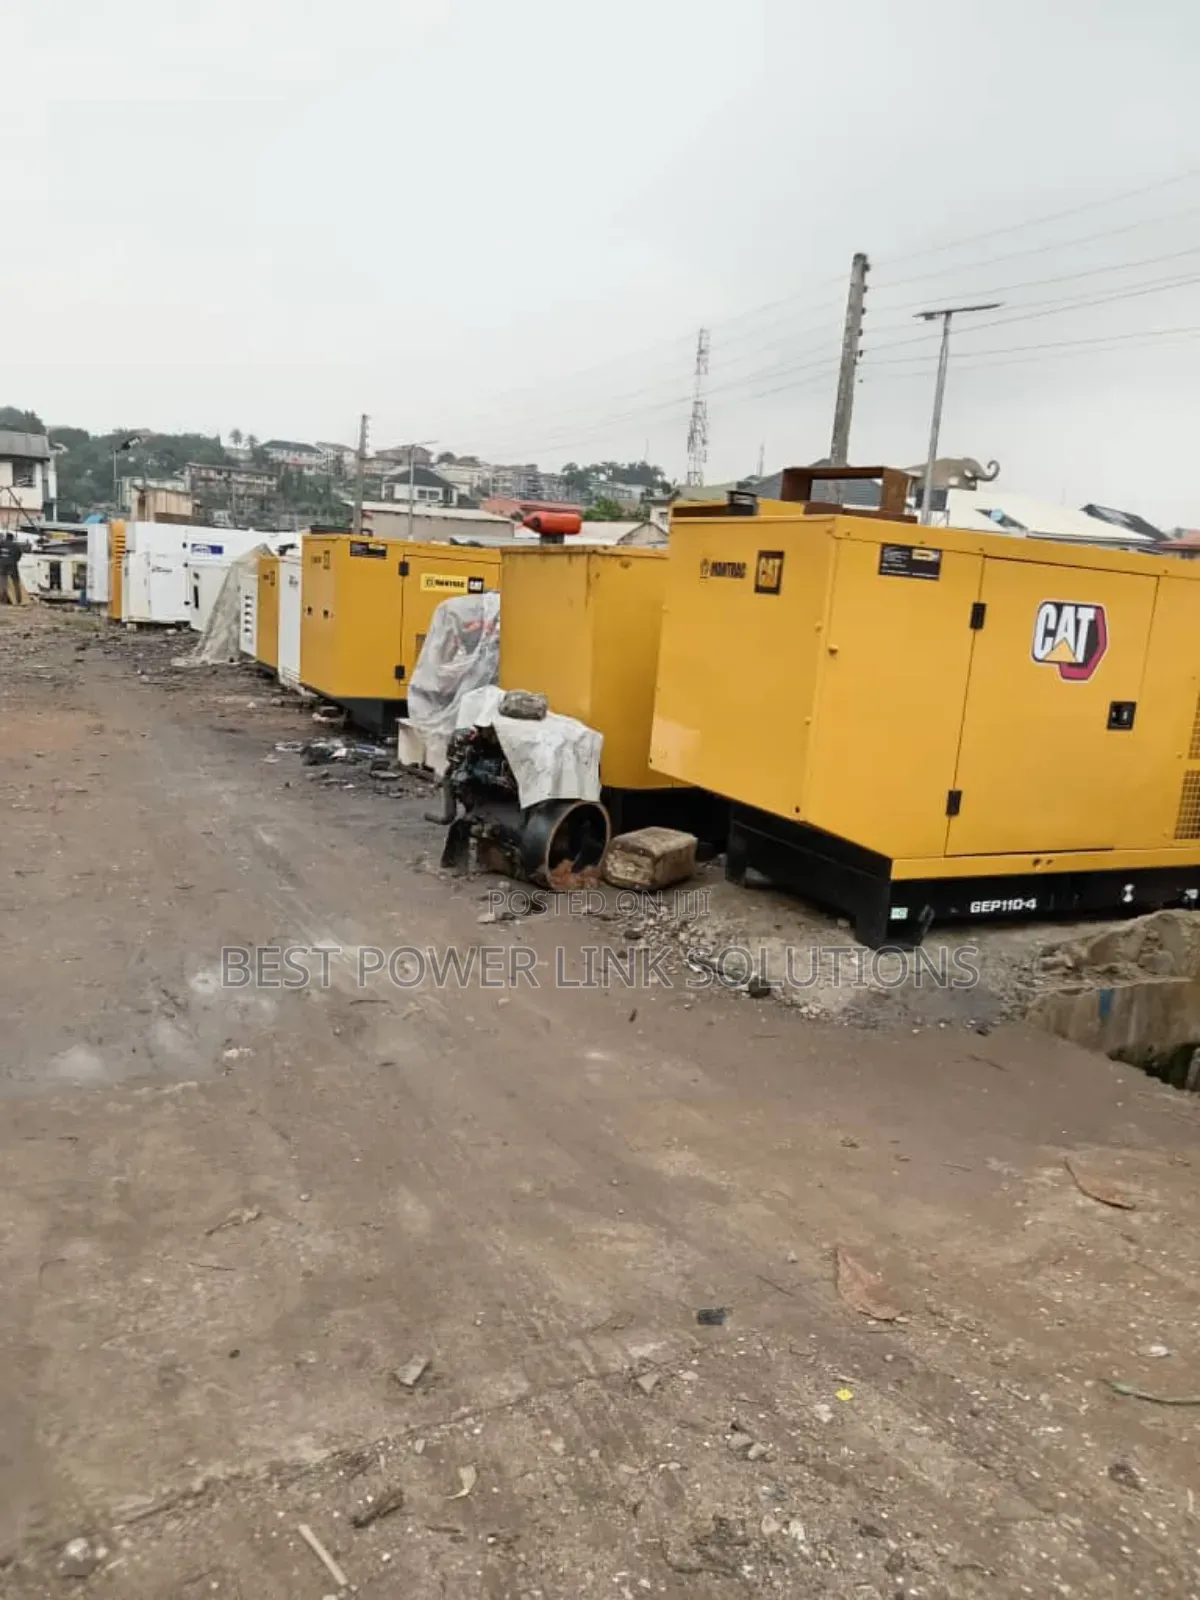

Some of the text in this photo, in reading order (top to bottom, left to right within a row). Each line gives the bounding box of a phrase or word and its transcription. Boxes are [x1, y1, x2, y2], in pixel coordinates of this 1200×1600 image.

[758, 557, 781, 588] CAT
[1033, 602, 1097, 664] CAT
[970, 898, 1038, 914] GEP110-4
